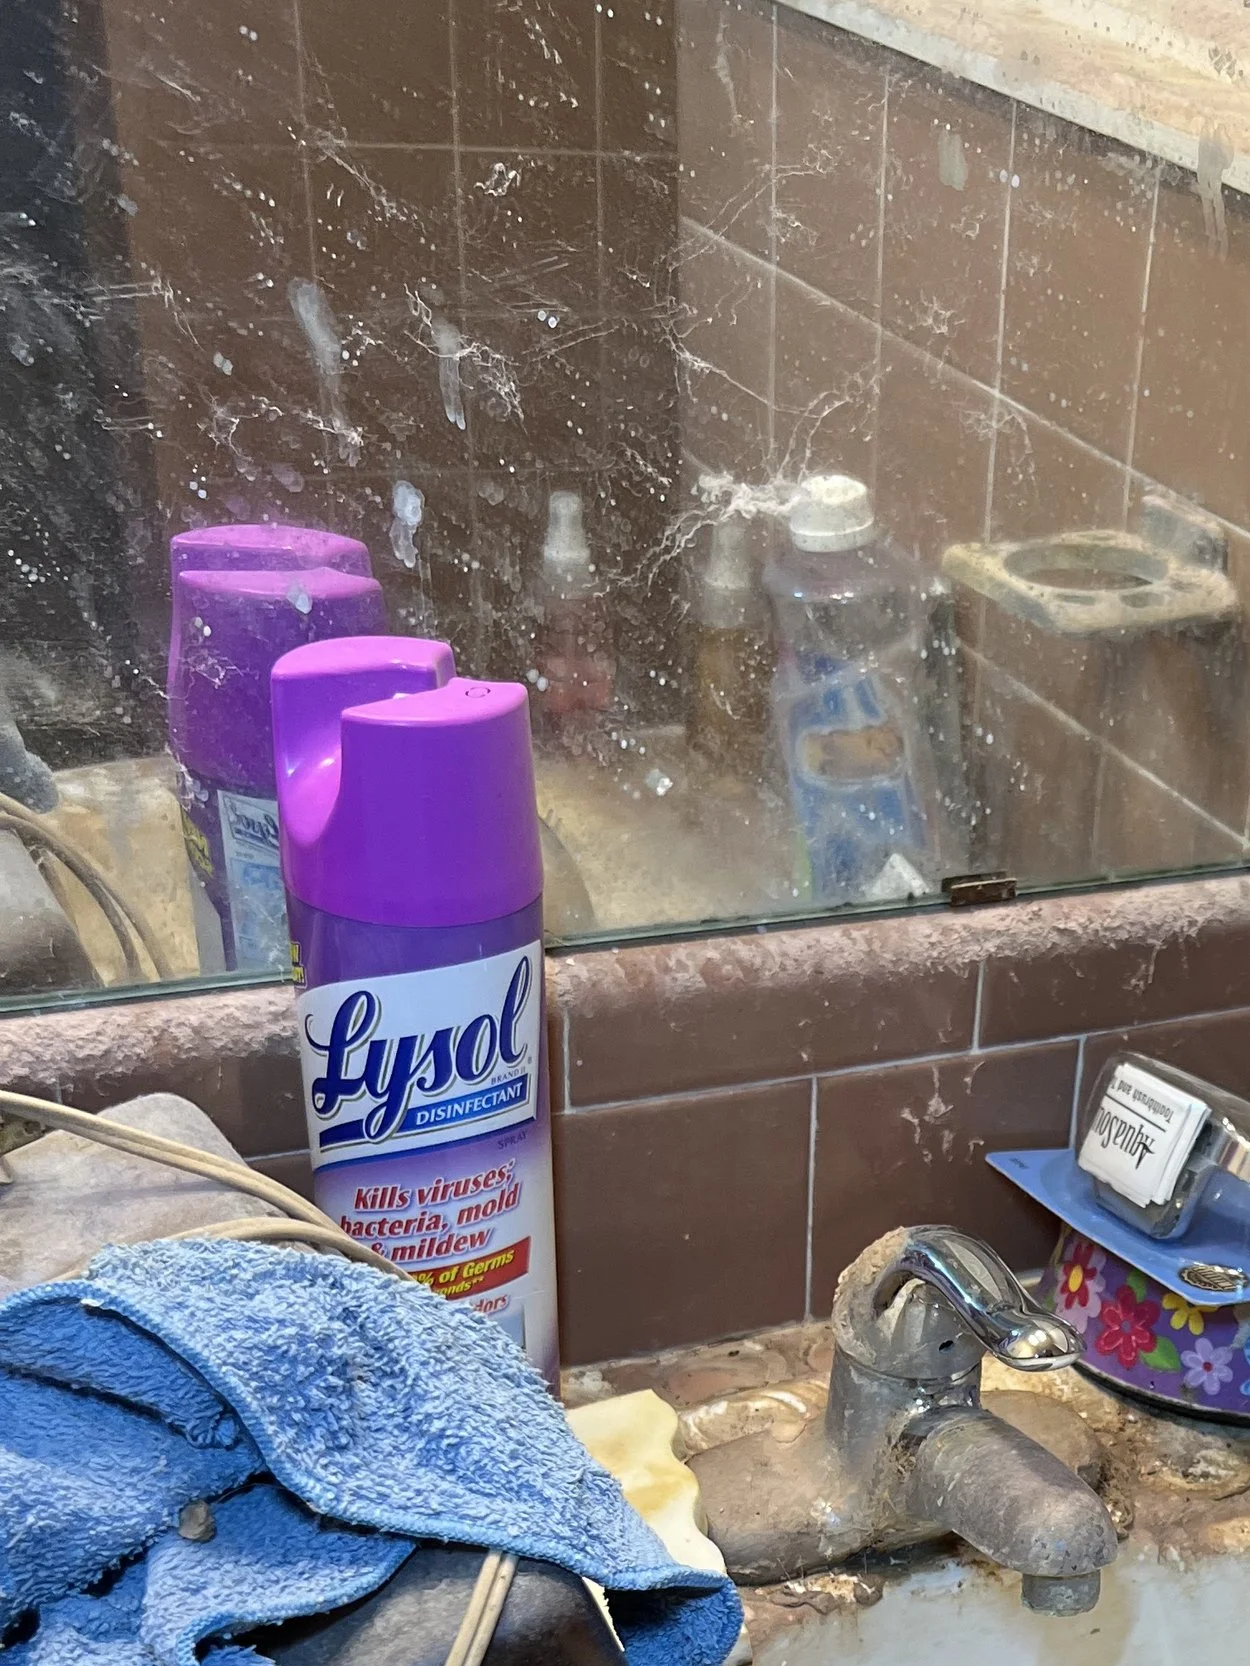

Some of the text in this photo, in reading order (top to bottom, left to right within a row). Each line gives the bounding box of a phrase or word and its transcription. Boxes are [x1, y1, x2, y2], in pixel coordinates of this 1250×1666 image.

[305, 956, 530, 1141] Lysol
[416, 1082, 523, 1125] DISINFECTANT
[498, 1132, 528, 1149] SPRAY
[1090, 1105, 1155, 1170] AquaSou
[340, 1183, 520, 1238] bacteria, mold
[354, 1185, 409, 1211] Kills
[391, 1229, 491, 1262] mildew
[439, 1266, 459, 1284] of
[463, 1250, 515, 1279] Germs
